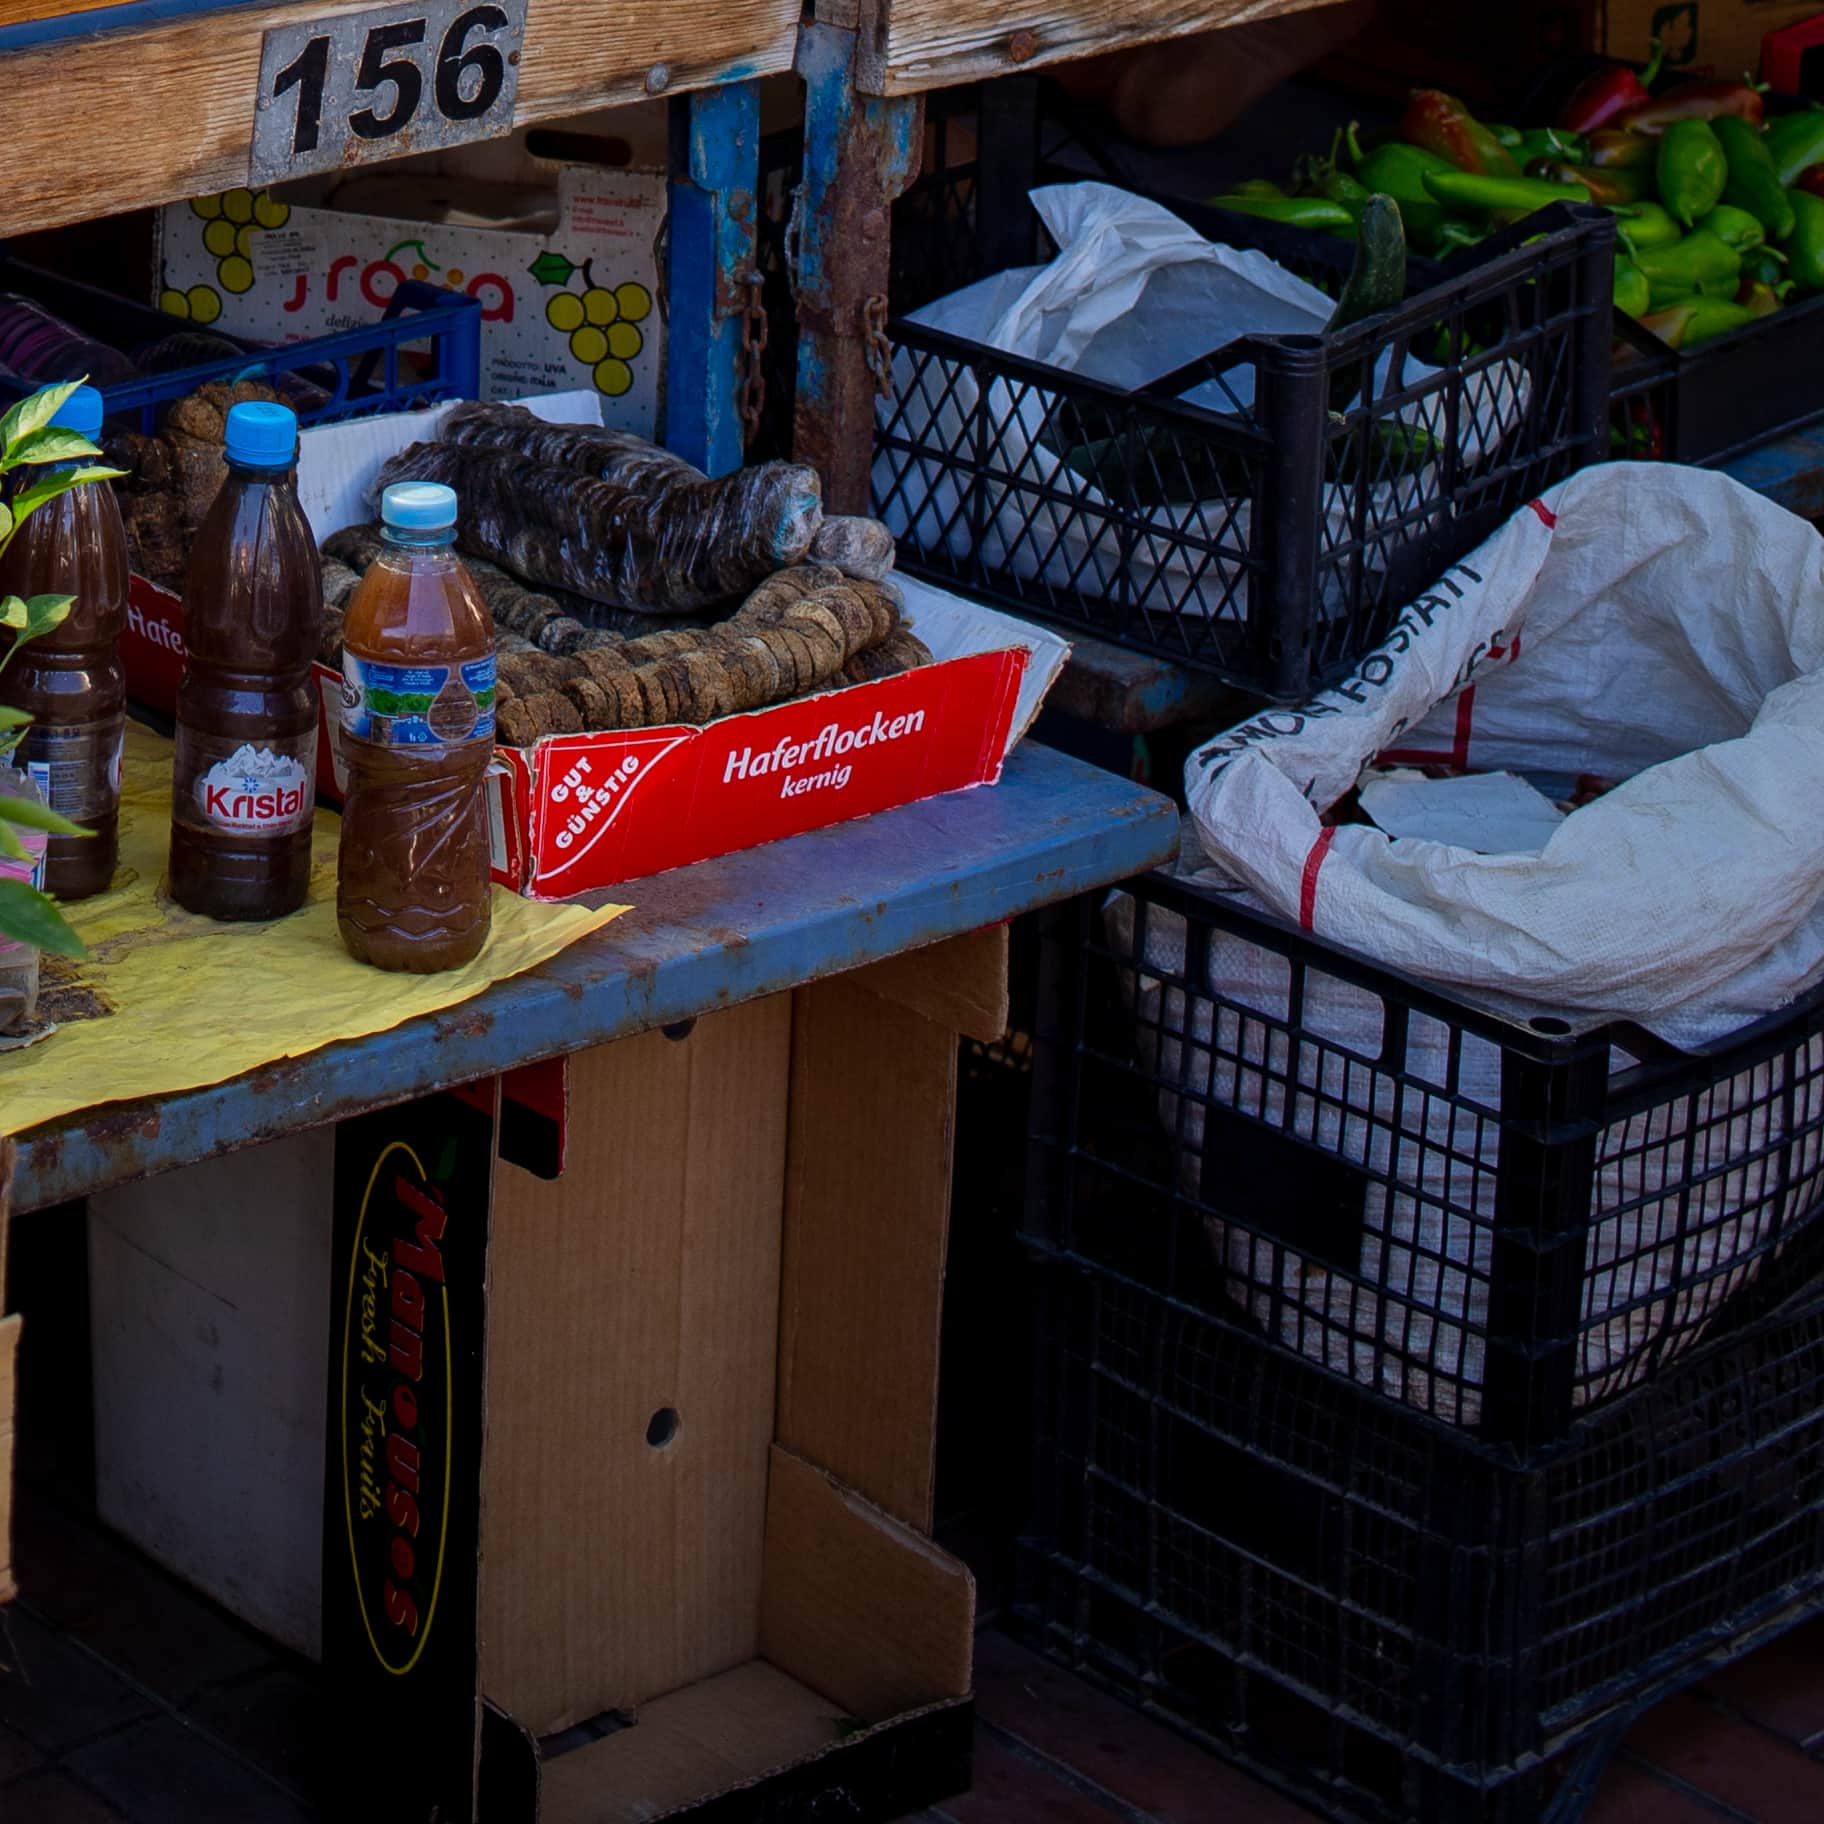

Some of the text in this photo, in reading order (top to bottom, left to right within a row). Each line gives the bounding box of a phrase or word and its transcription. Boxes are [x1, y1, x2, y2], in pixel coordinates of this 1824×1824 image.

[273, 4, 509, 154] 156
[544, 363, 567, 375] UVA
[722, 710, 926, 784] Haferflocken
[206, 780, 305, 819] Kristal
[551, 755, 594, 804] GUT
[555, 755, 640, 850] GÜNSTIG
[578, 784, 596, 804] &
[780, 762, 853, 801] kernig
[359, 1235, 388, 1521] Fresh Fruits
[384, 1174, 449, 1638] Manousos
